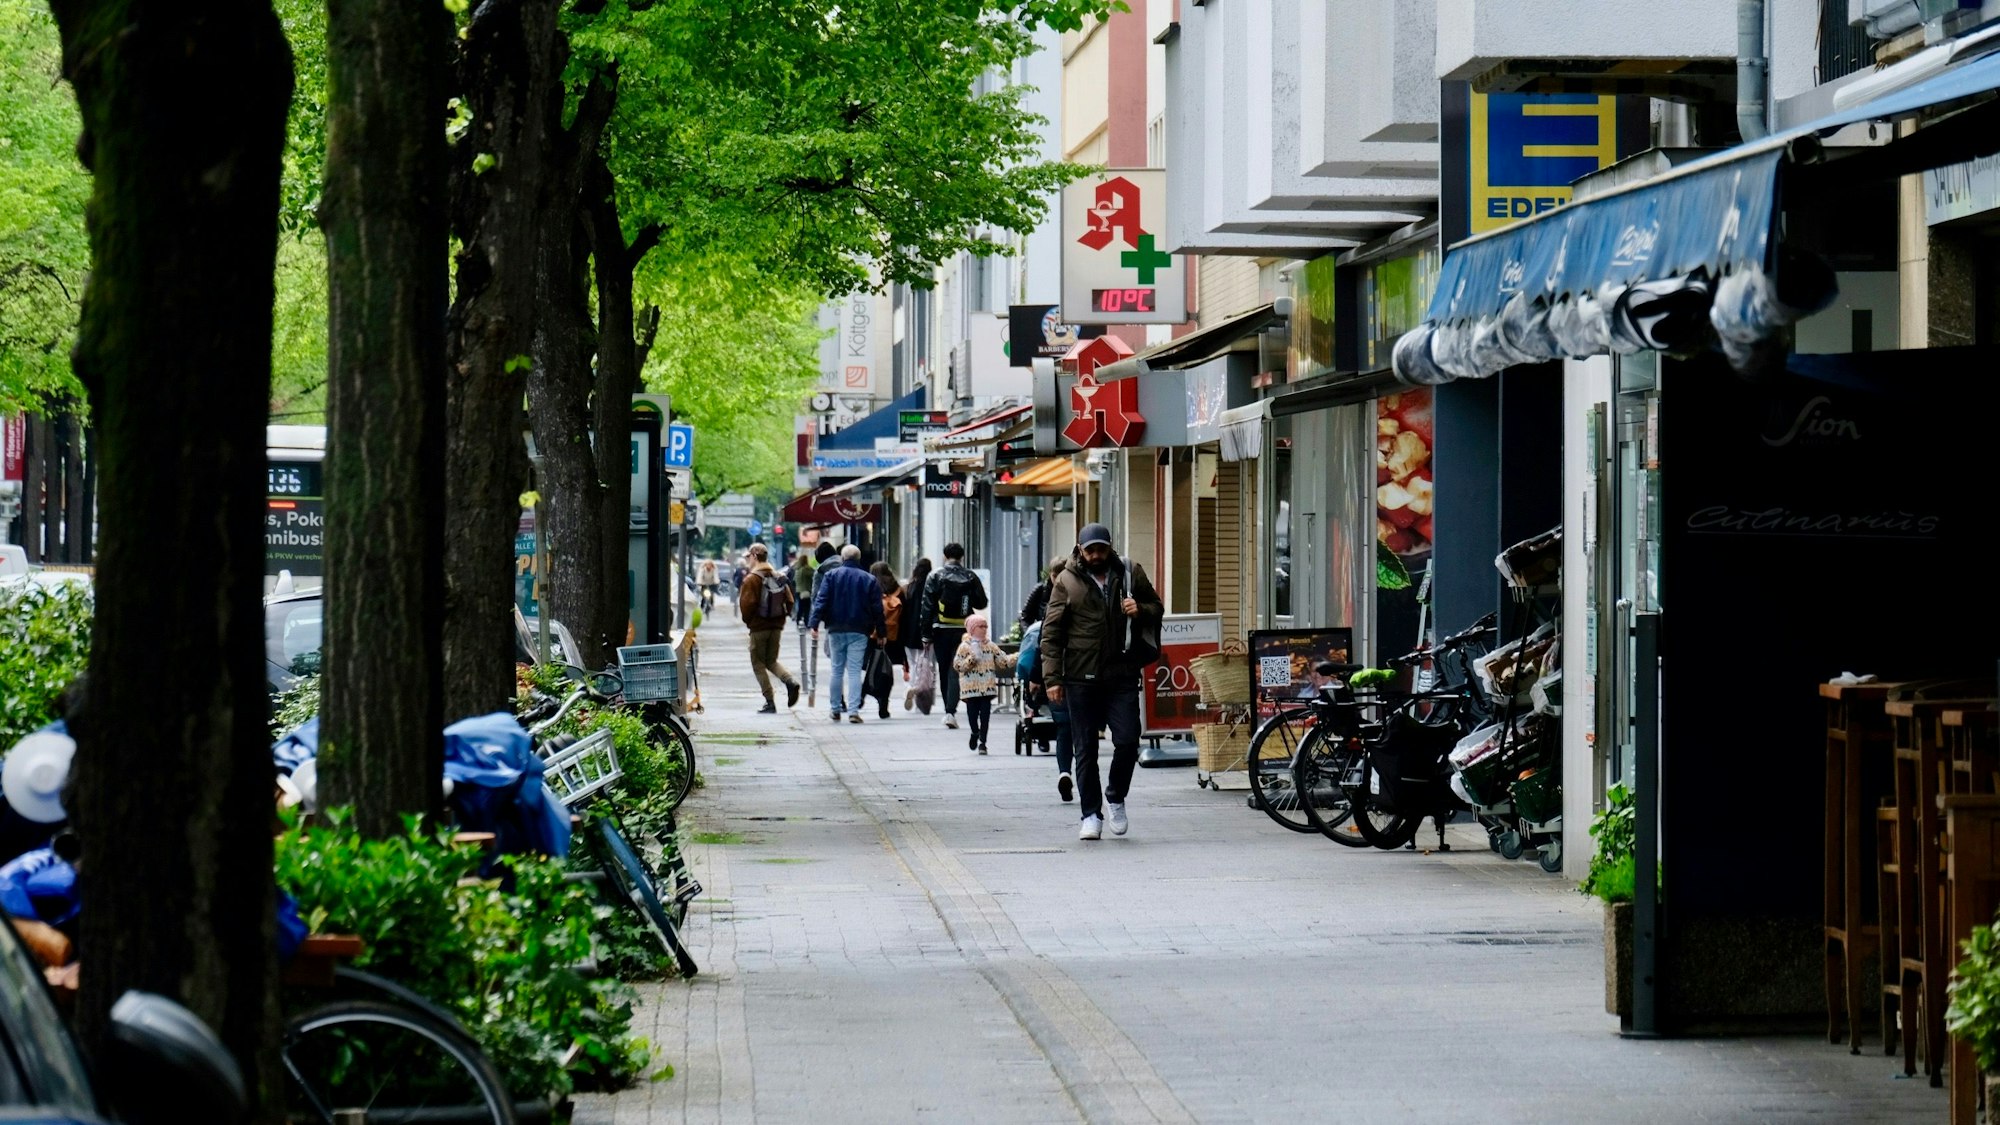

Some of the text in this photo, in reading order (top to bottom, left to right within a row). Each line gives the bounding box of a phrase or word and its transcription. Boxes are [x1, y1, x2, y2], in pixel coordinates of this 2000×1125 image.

[1488, 197, 1572, 218] EDE
[1101, 289, 1151, 312] 10°C
[848, 294, 870, 357] Köttgen
[1760, 396, 1862, 447] Sion
[670, 430, 685, 461] P
[1162, 624, 1196, 633] VICHY
